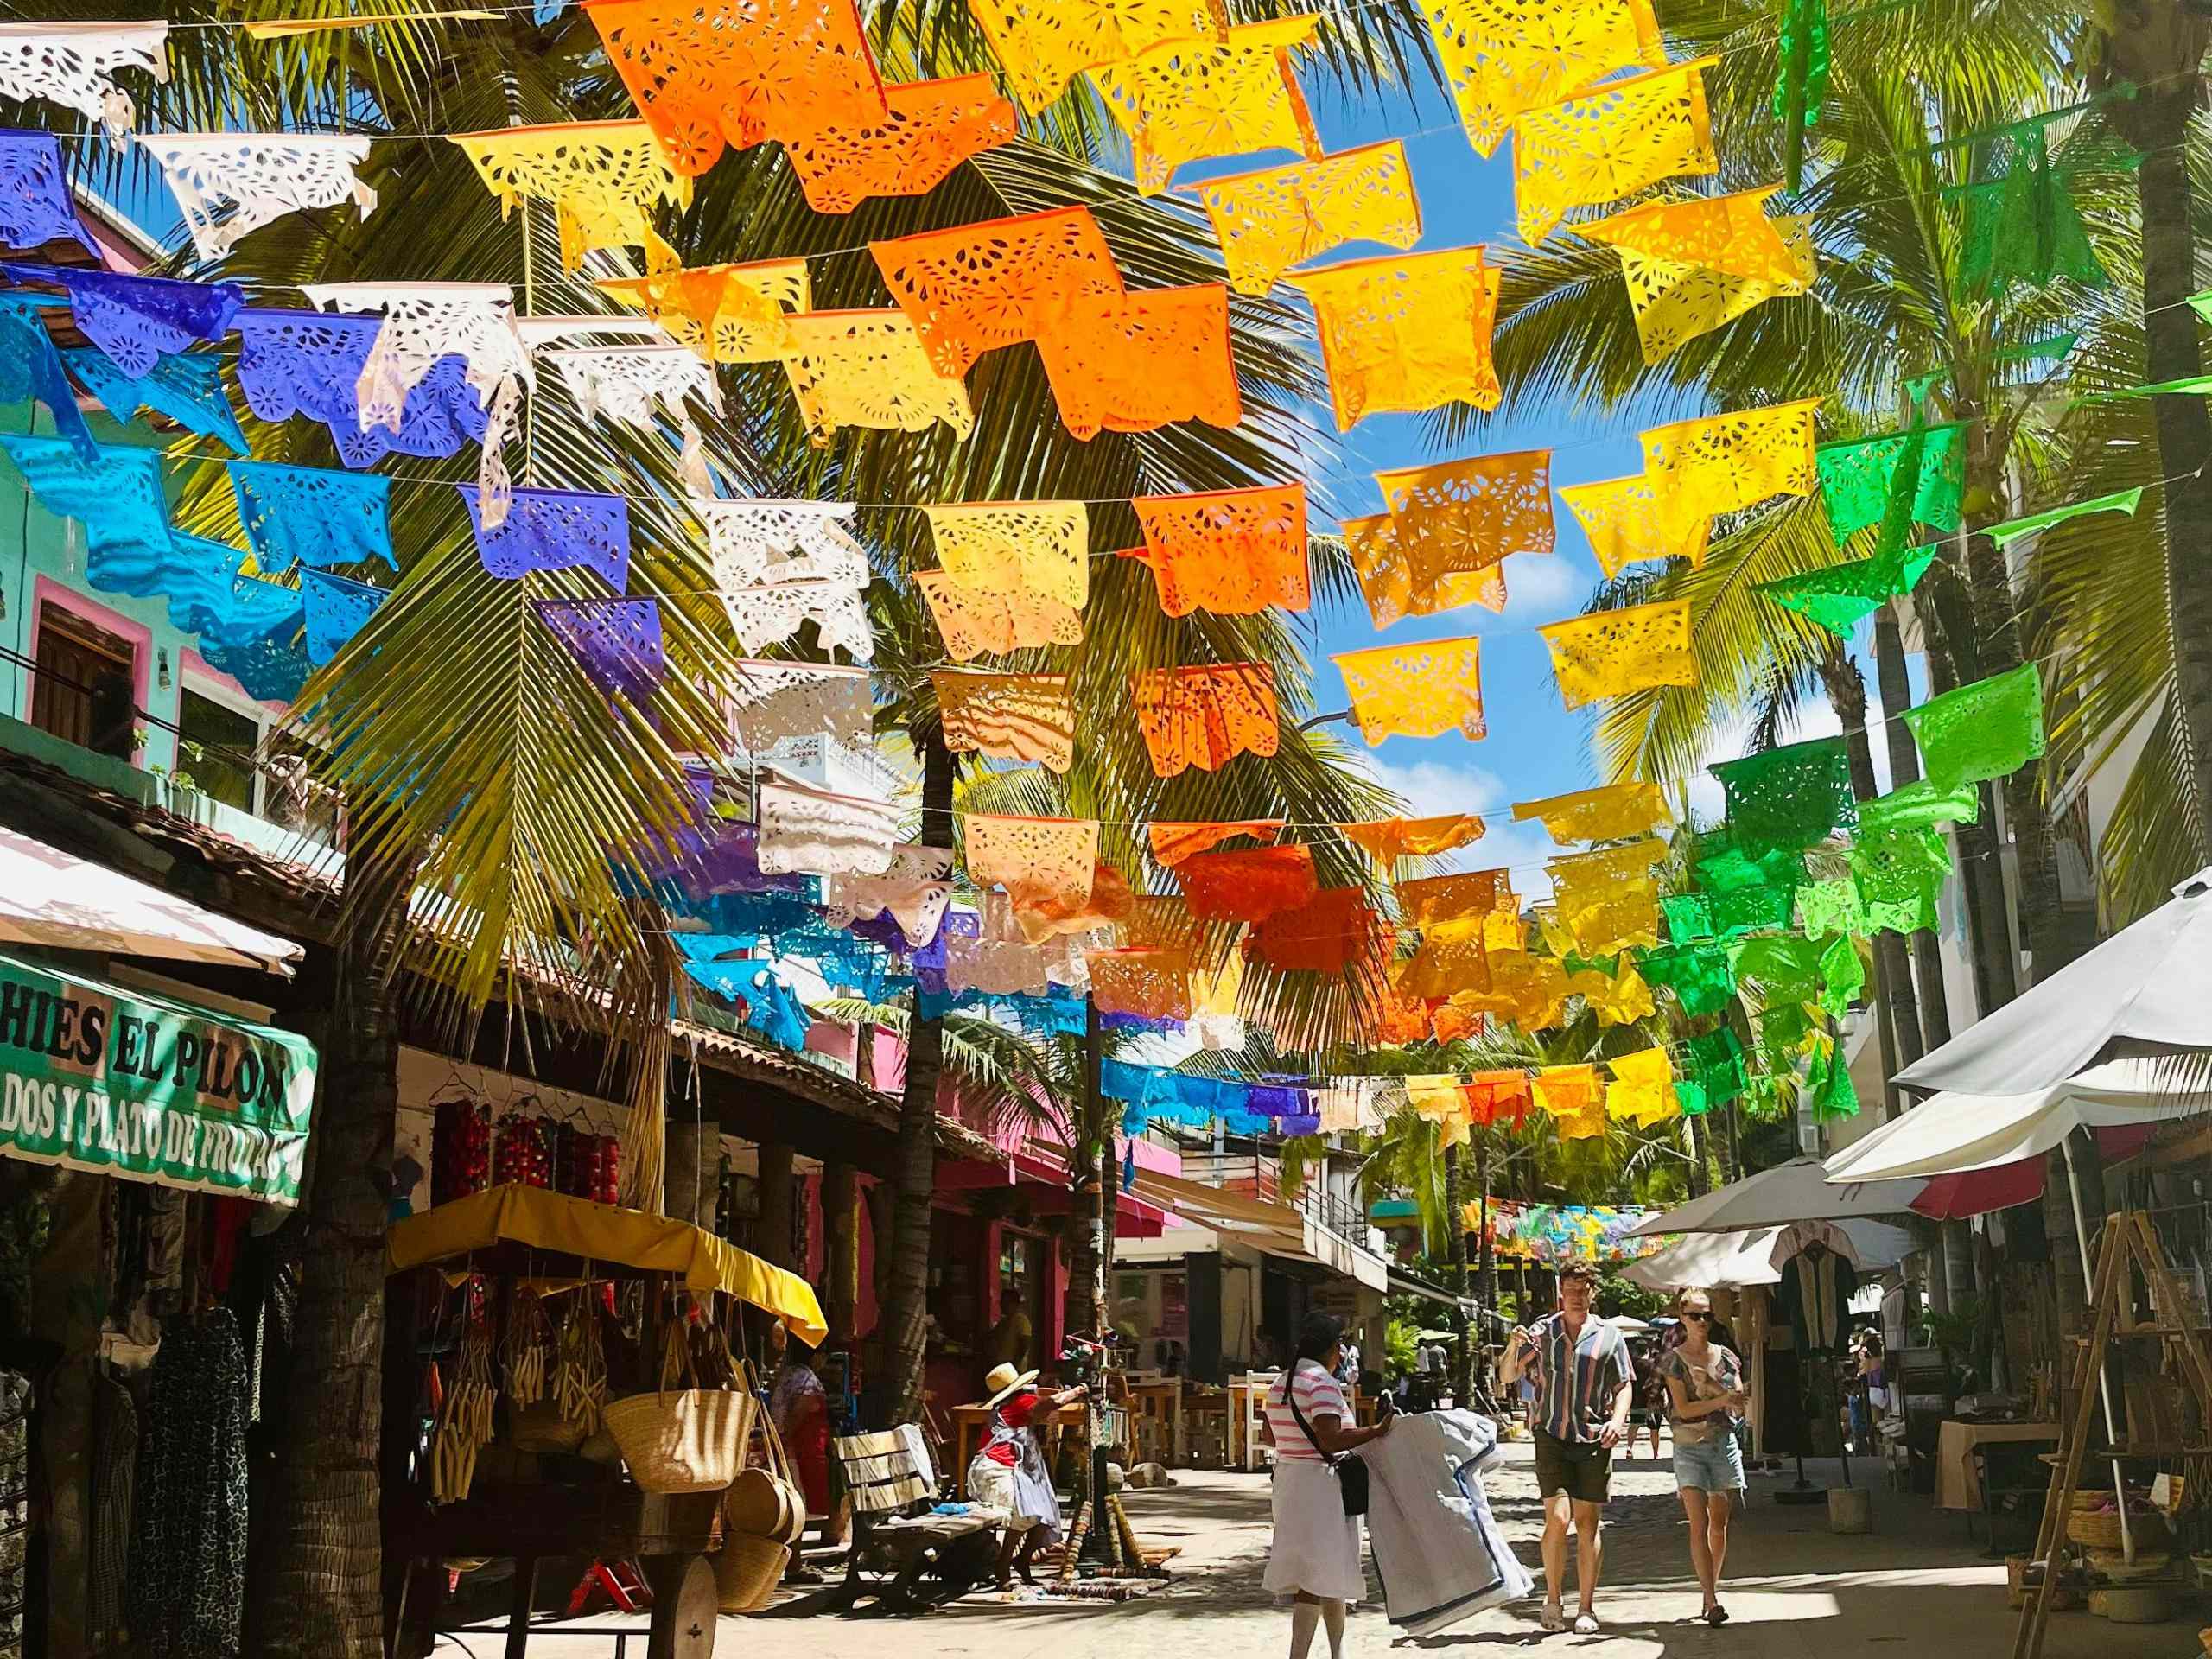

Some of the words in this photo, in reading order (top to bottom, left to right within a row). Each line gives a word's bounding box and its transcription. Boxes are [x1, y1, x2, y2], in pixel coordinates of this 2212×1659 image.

[113, 1014, 162, 1081] EL
[60, 1086, 81, 1142] Y
[82, 1092, 162, 1159] PLATO
[165, 1110, 200, 1166] DE
